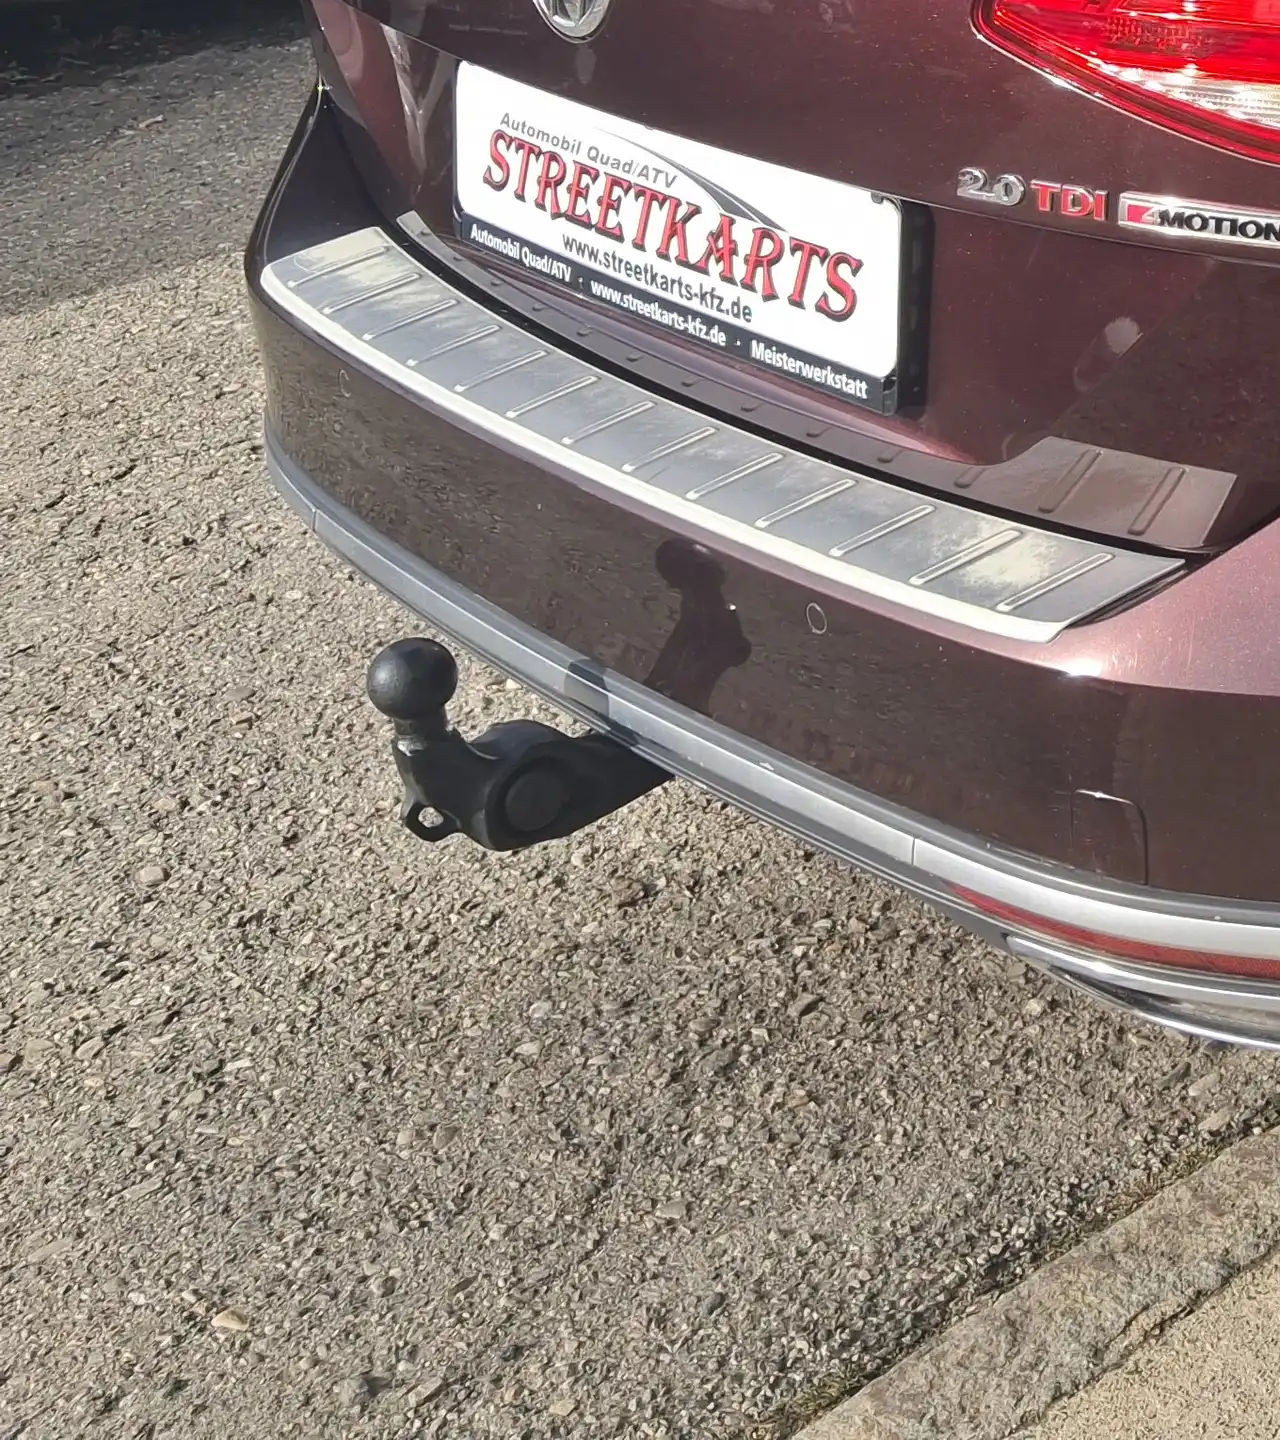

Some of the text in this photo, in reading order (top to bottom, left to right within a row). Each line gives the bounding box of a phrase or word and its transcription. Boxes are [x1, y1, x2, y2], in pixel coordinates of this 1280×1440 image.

[500, 112, 677, 189] Automobil Quad/ATV
[956, 167, 1025, 207] 2.0
[1030, 178, 1109, 221] TDI
[482, 129, 864, 322] STREETKARTS
[470, 223, 869, 400] Automobil Quad/ATV www.streetkarts-kfz.de Meisterwerkstatt
[562, 233, 753, 324] www.streetkarts-kfz.de
